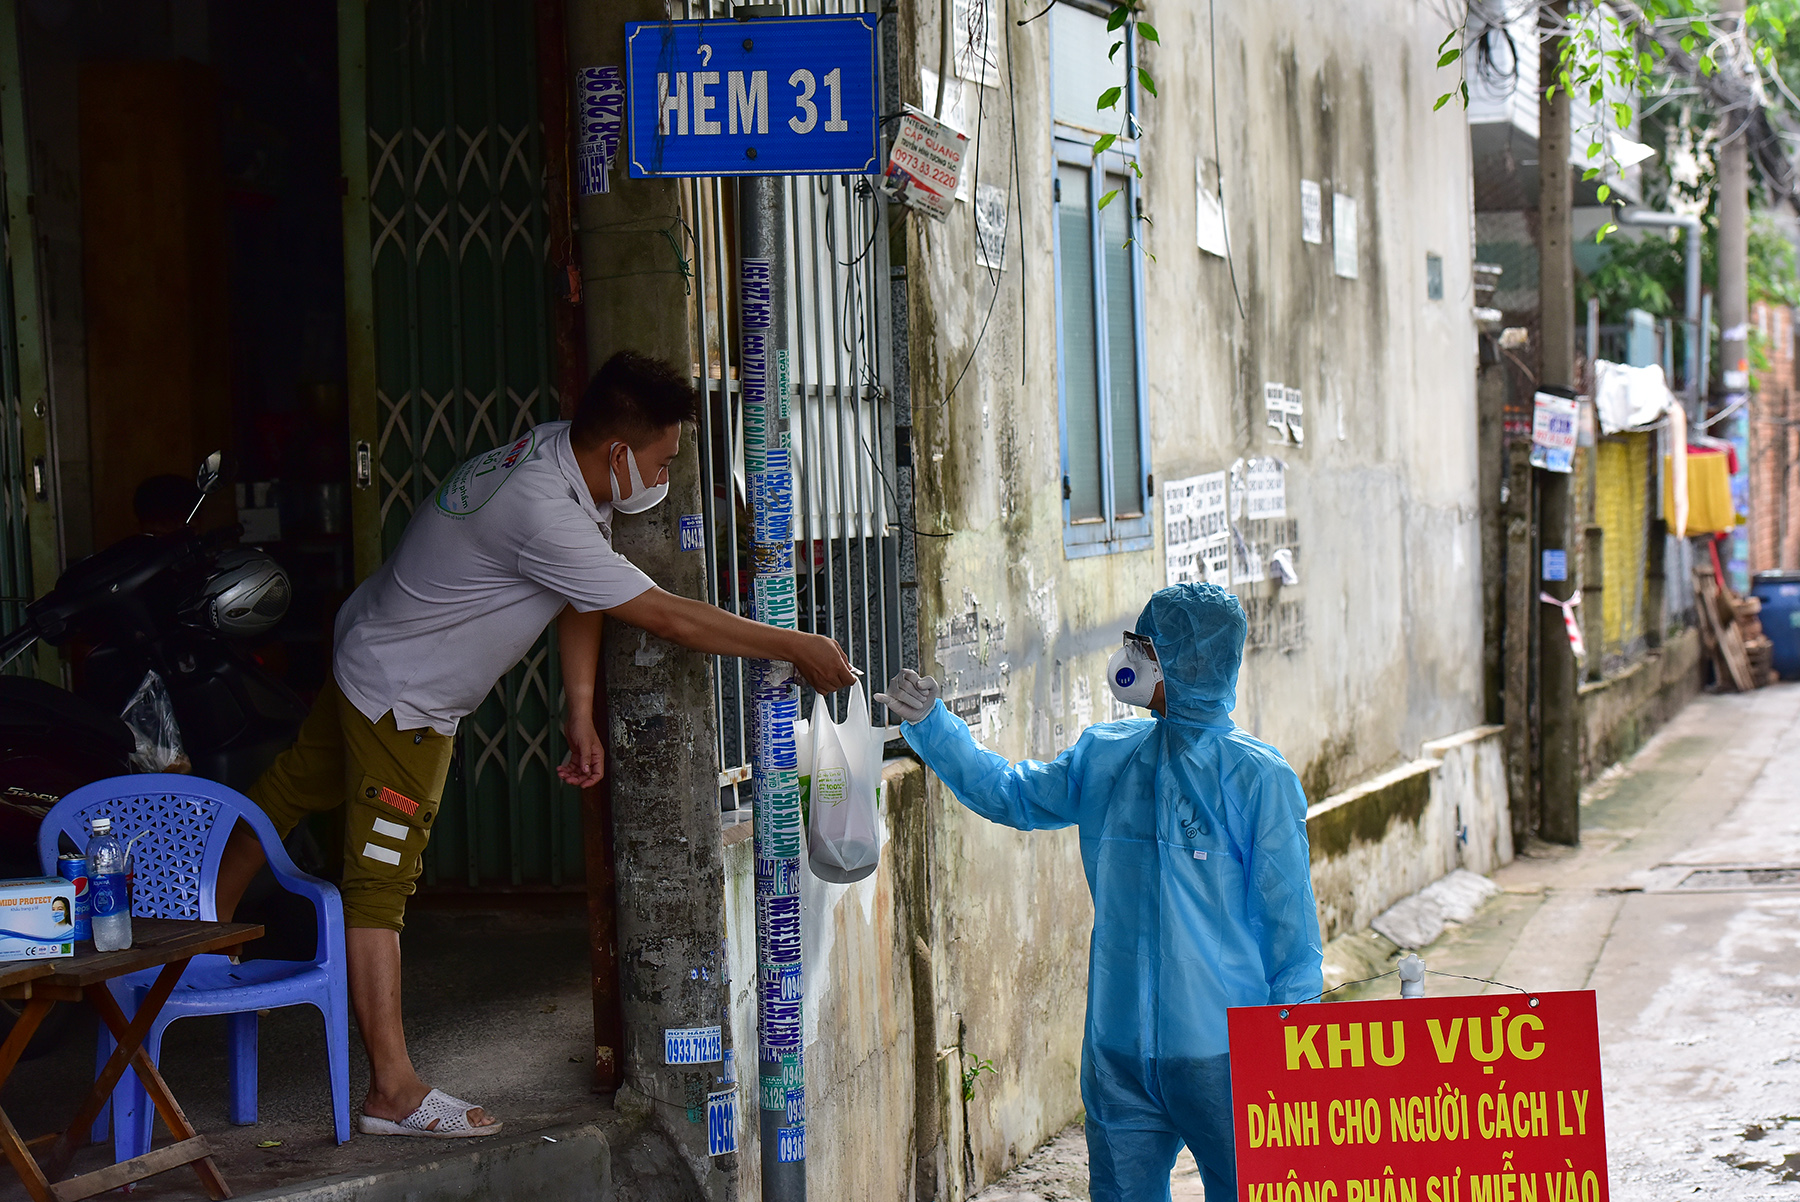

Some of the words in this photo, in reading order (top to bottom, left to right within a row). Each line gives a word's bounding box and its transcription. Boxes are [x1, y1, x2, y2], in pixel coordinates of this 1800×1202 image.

[657, 44, 769, 135] HẺM
[788, 67, 848, 134] 31
[903, 117, 939, 139] INTERNET
[894, 148, 957, 189] 0973.83.2220
[925, 138, 960, 162] QUANG
[19, 896, 52, 906] PROTECT
[667, 1036, 721, 1063] 0933.712.125
[1284, 1020, 1406, 1071] KHU
[1426, 1006, 1546, 1075] VỰC
[1247, 1090, 1320, 1149] DÀNH
[1327, 1097, 1382, 1145] CHO
[1390, 1083, 1470, 1143] NGƯỜI
[1477, 1080, 1549, 1140] CÁCH
[1557, 1089, 1590, 1137] LY
[1545, 1158, 1601, 1202] VÀO
